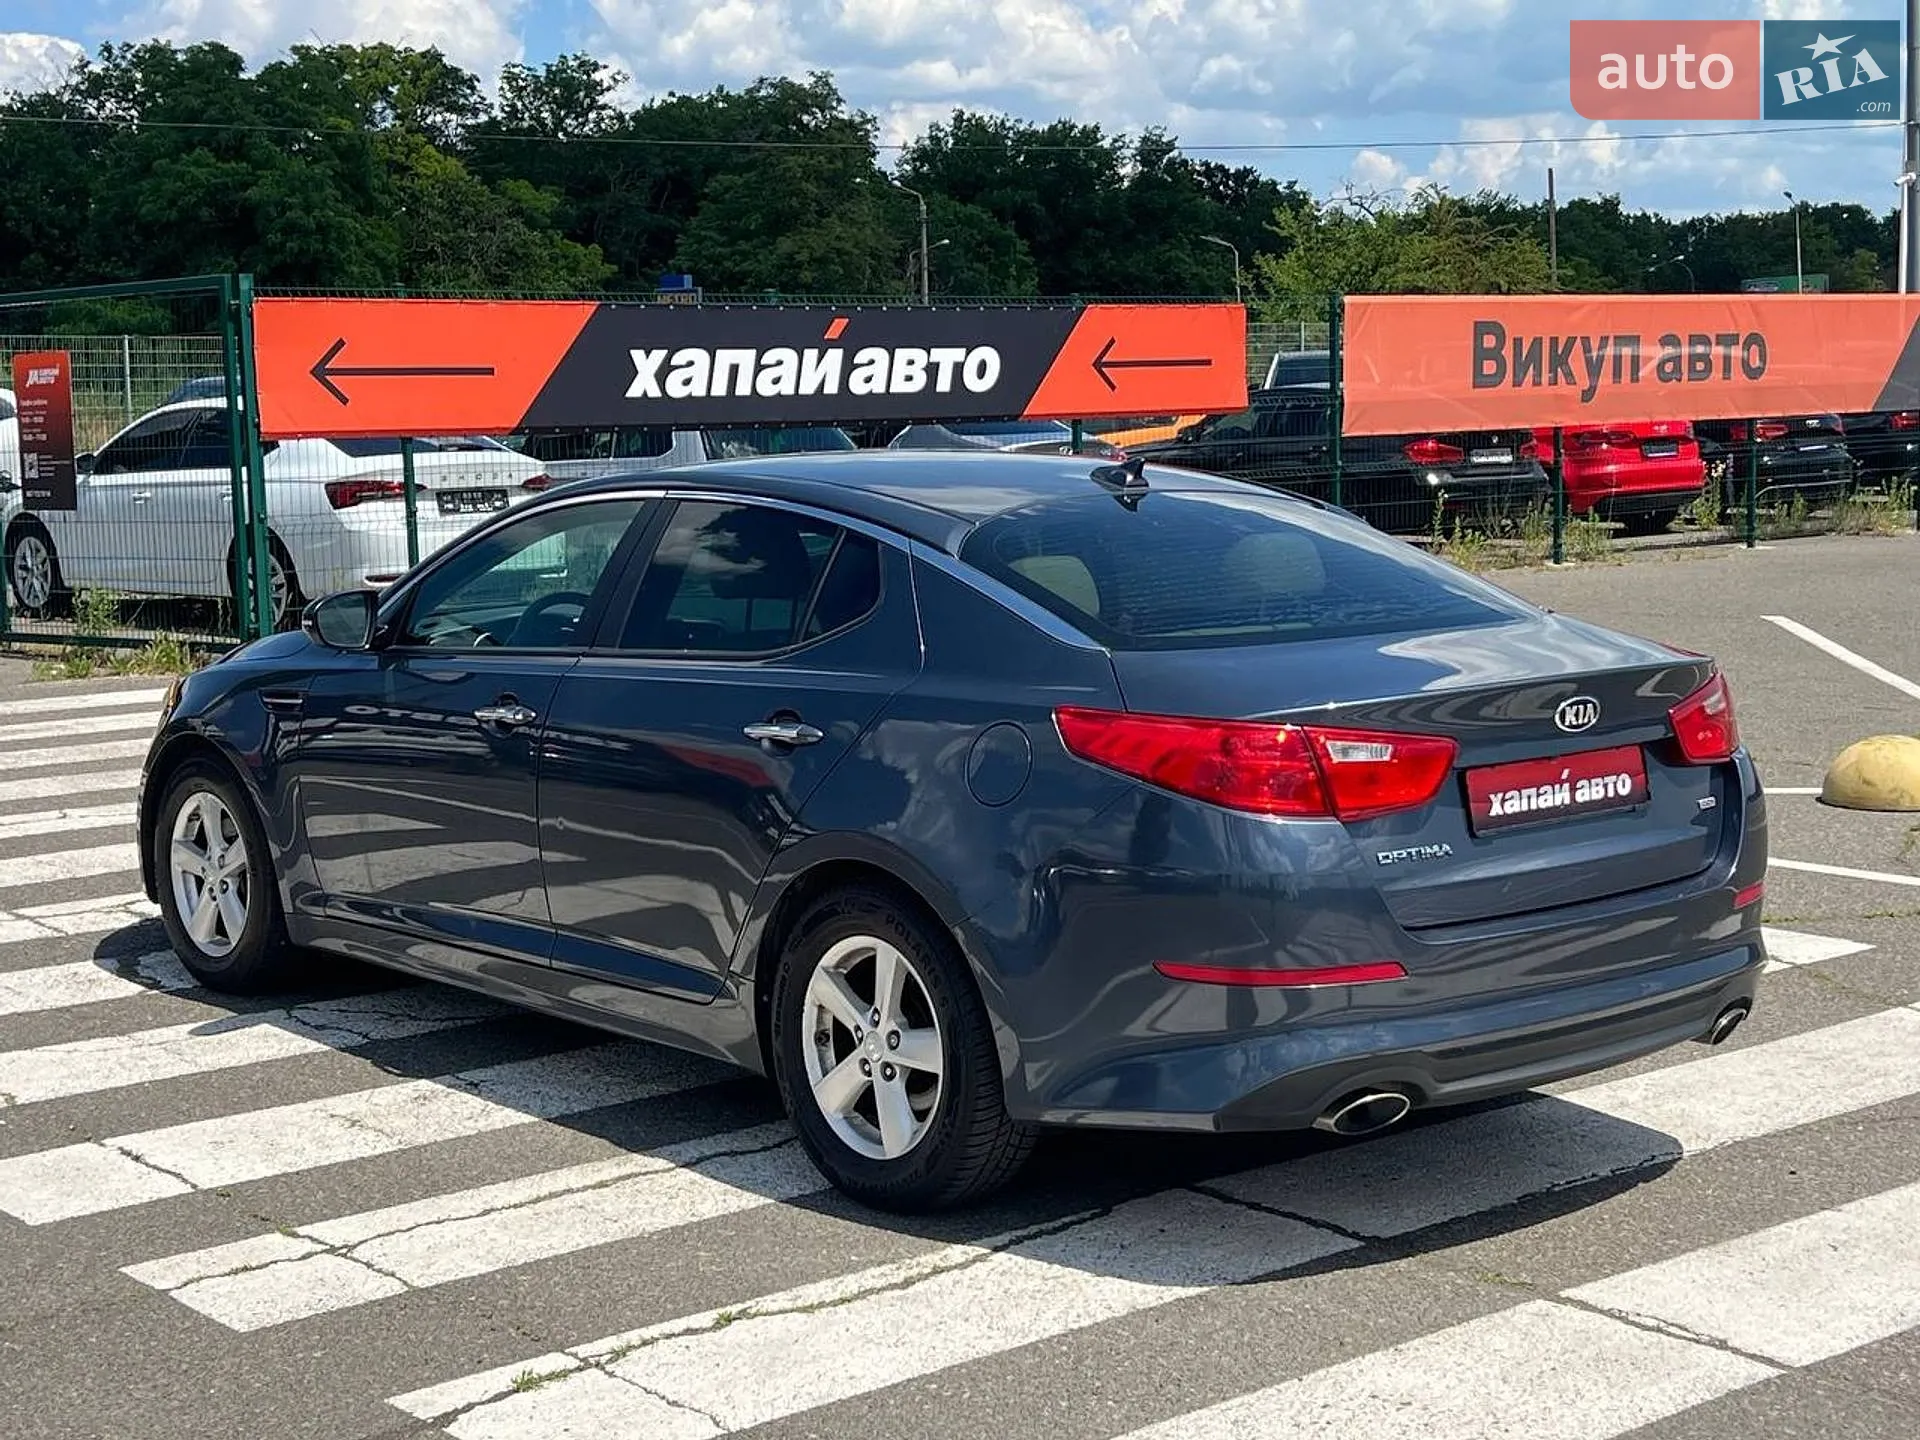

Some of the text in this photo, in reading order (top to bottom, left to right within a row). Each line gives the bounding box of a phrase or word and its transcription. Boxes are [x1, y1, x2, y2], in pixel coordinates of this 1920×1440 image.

[624, 316, 1001, 399] хапай авто
[1472, 320, 1767, 403] Викуп авто
[1564, 703, 1595, 726] KIA
[1488, 768, 1632, 817] хапай авто
[1376, 843, 1453, 865] OPTIMA
